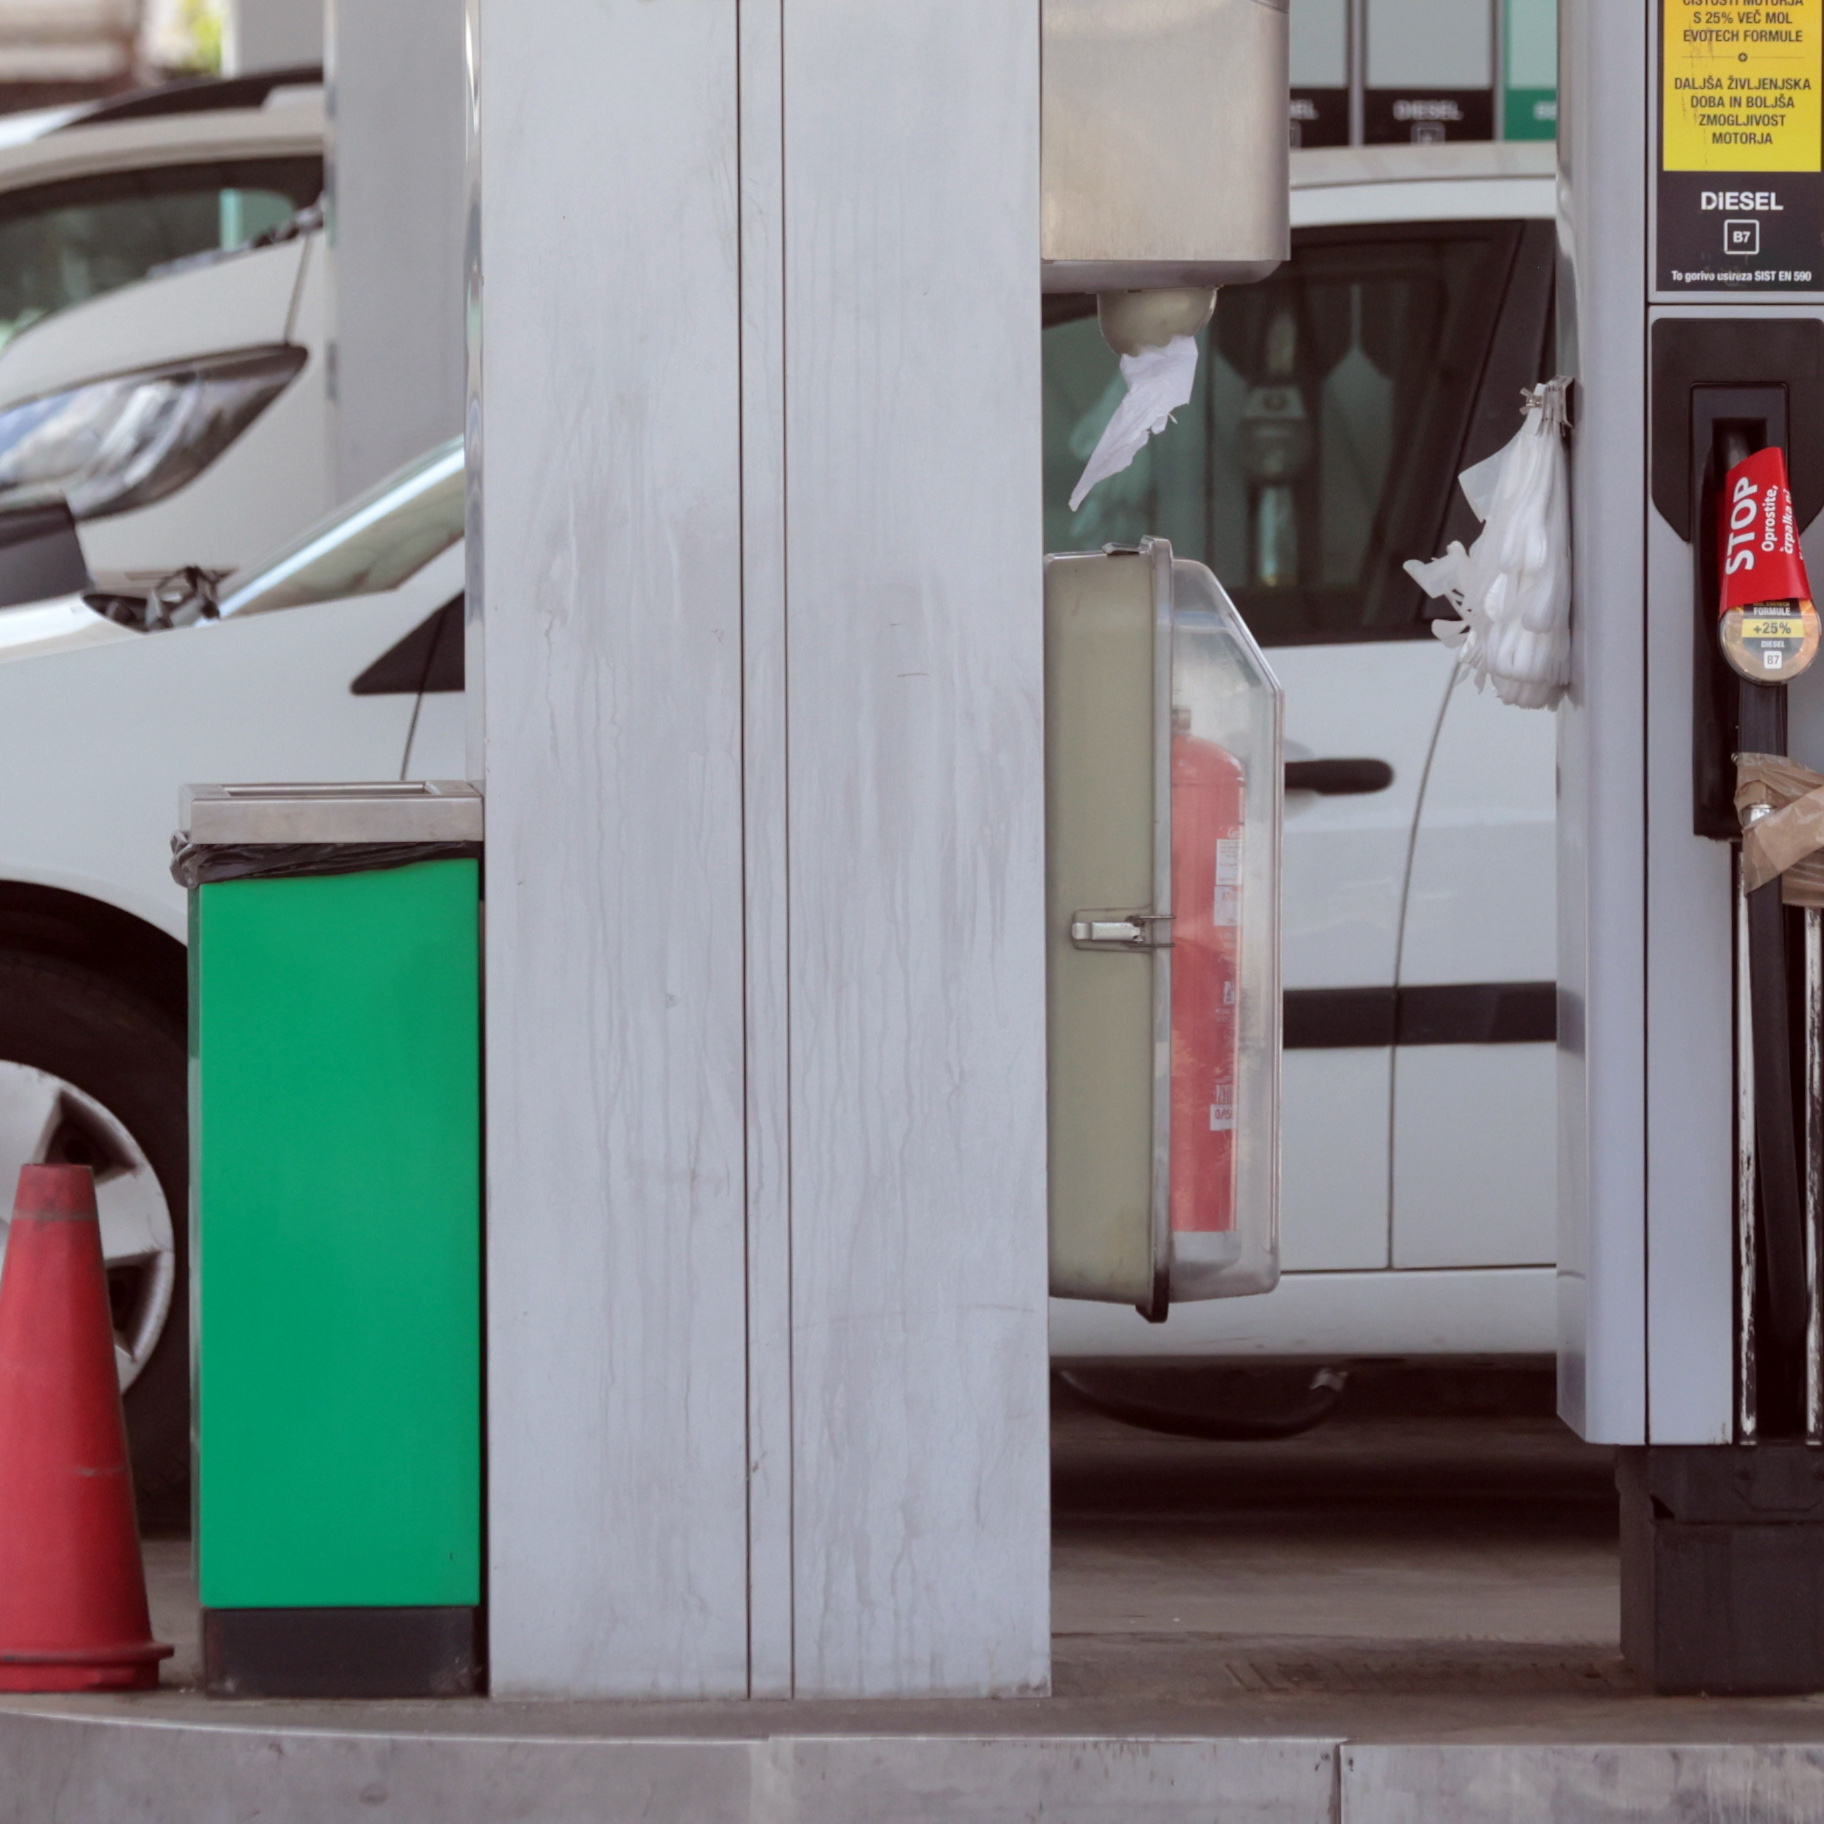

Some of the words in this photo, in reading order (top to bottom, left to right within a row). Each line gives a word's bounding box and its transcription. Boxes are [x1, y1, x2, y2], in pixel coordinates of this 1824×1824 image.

[1693, 11, 1702, 24] S
[1704, 11, 1734, 25] 25%
[1737, 8, 1762, 25] VEČ
[1765, 11, 1793, 25] MOL
[1683, 29, 1740, 43] EVOTECH
[1743, 29, 1803, 43] FORMULE
[1674, 74, 1724, 90] DALJŠA
[1726, 74, 1812, 91] ŽIVLJENJSKA
[1690, 95, 1726, 109] DOBA
[1729, 95, 1742, 109] IN
[1745, 93, 1796, 109] BOLJŠA
[1698, 113, 1786, 127] ZMOGLJIVOST
[1711, 131, 1774, 145] MOTORJA
[1700, 191, 1784, 211] DIESEL
[1732, 230, 1751, 243] B7
[1671, 269, 1684, 281] To
[1684, 270, 1716, 283] gorivo
[1716, 271, 1753, 282] ustreza
[1754, 270, 1777, 282] SIST
[1778, 270, 1792, 282] EN
[1793, 270, 1812, 282] 590
[1761, 484, 1779, 553] Oprostite,
[1725, 476, 1759, 576] STOP
[1753, 606, 1791, 617] FORMULE
[1753, 622, 1792, 635] +25%
